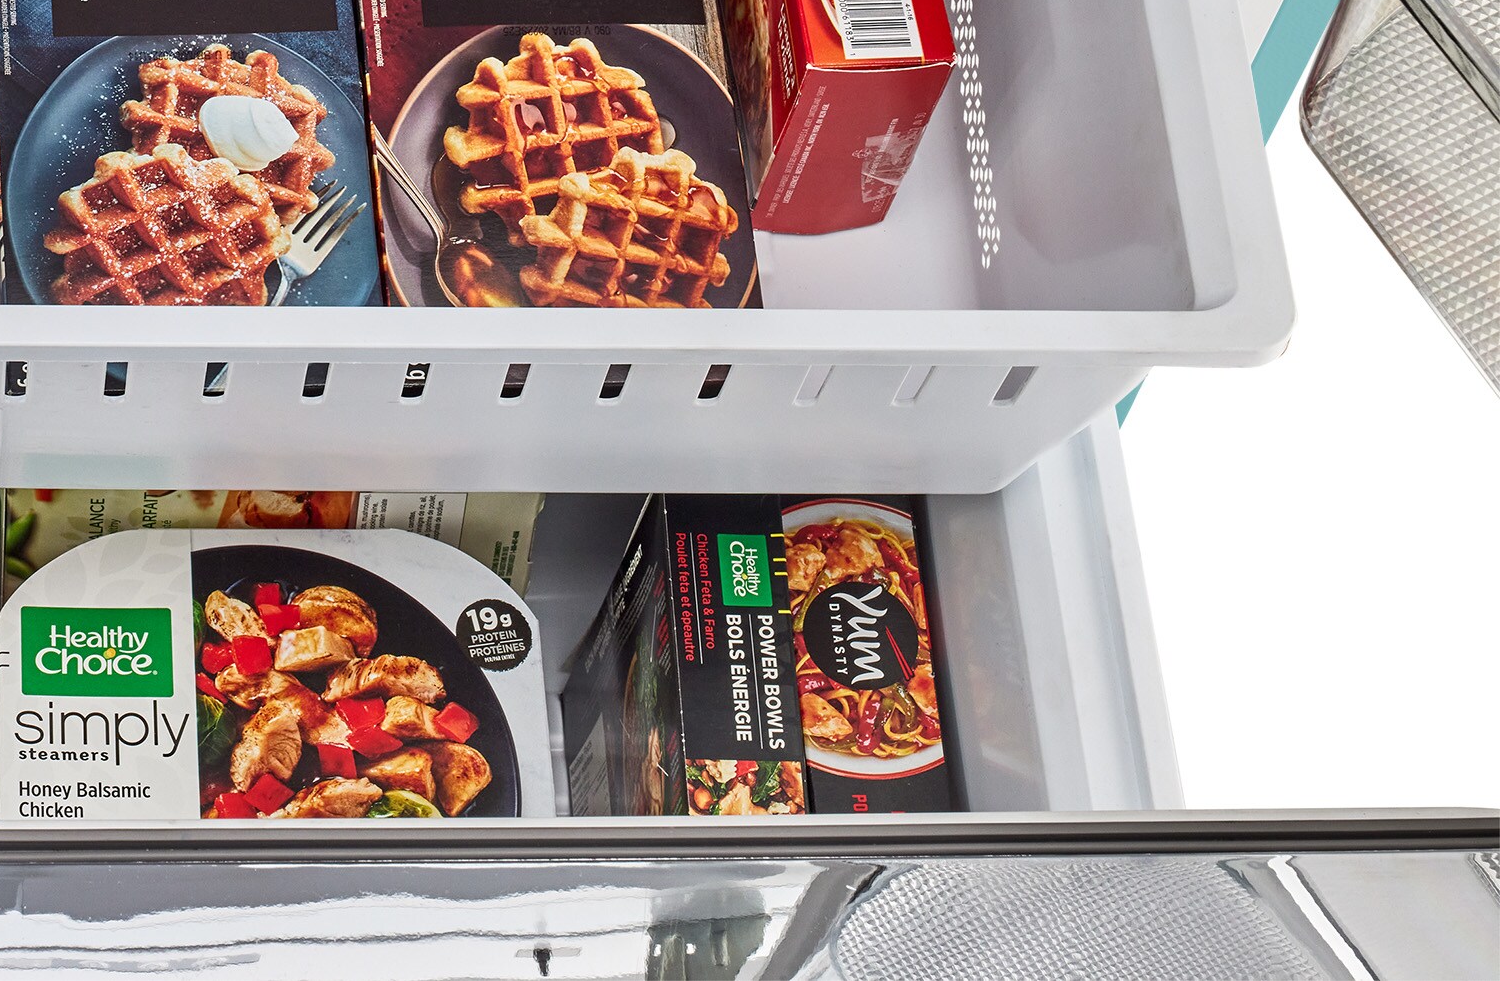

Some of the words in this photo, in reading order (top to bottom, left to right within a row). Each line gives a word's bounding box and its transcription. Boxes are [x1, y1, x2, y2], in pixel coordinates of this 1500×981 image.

[88, 498, 105, 540] ALANCE
[142, 492, 158, 529] ARFAIT
[675, 532, 688, 568] Poulet
[696, 533, 708, 577] Chicken
[678, 570, 689, 593] feta
[729, 540, 747, 597] Choice
[745, 548, 761, 596] Healthy
[680, 595, 691, 607] et
[700, 580, 712, 604] Feta
[702, 607, 714, 615] &
[49, 625, 149, 654] Healthy
[469, 642, 526, 658] PROTÉINES
[470, 629, 517, 644] PROTEIN
[681, 610, 694, 661] épeautre
[704, 618, 715, 649] Farro
[725, 614, 745, 659] BOLS
[757, 614, 778, 679] POWER
[828, 603, 848, 674] DYNASTY
[830, 585, 888, 685] Yum
[35, 647, 153, 675] Choice
[730, 664, 752, 741] ÉNERGIE
[764, 684, 785, 749] BOWLS
[14, 700, 190, 766] simply
[18, 748, 110, 762] steamers
[19, 781, 72, 800] Honey
[77, 782, 151, 798] Balsamic
[19, 801, 84, 818] Chicken
